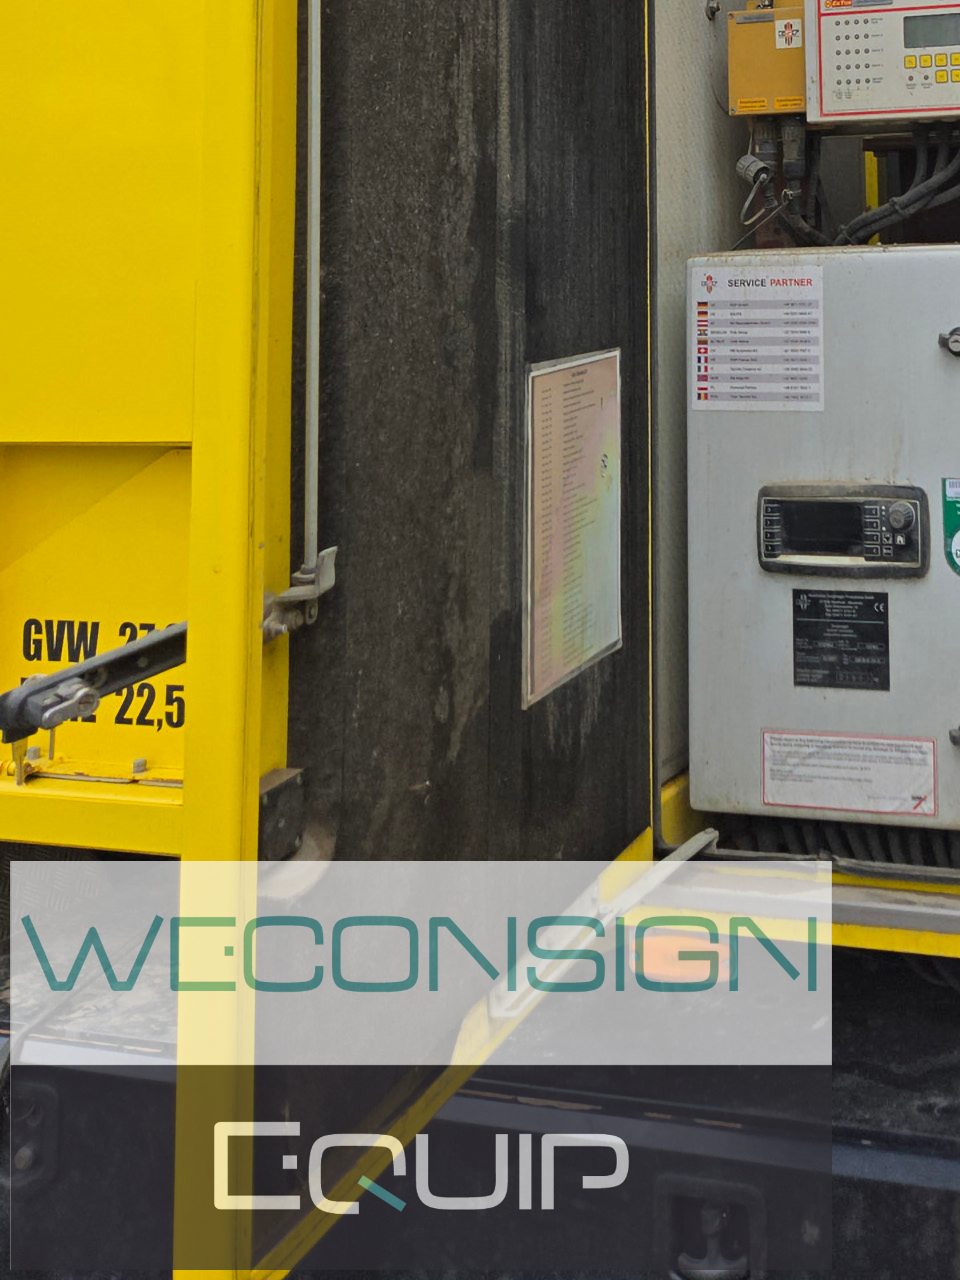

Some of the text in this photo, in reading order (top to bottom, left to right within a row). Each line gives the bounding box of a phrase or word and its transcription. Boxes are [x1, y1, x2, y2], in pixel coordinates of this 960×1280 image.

[727, 279, 766, 287] SERVICE
[770, 278, 813, 287] PARTNER
[22, 618, 100, 663] GVW
[114, 682, 186, 732] 22,5
